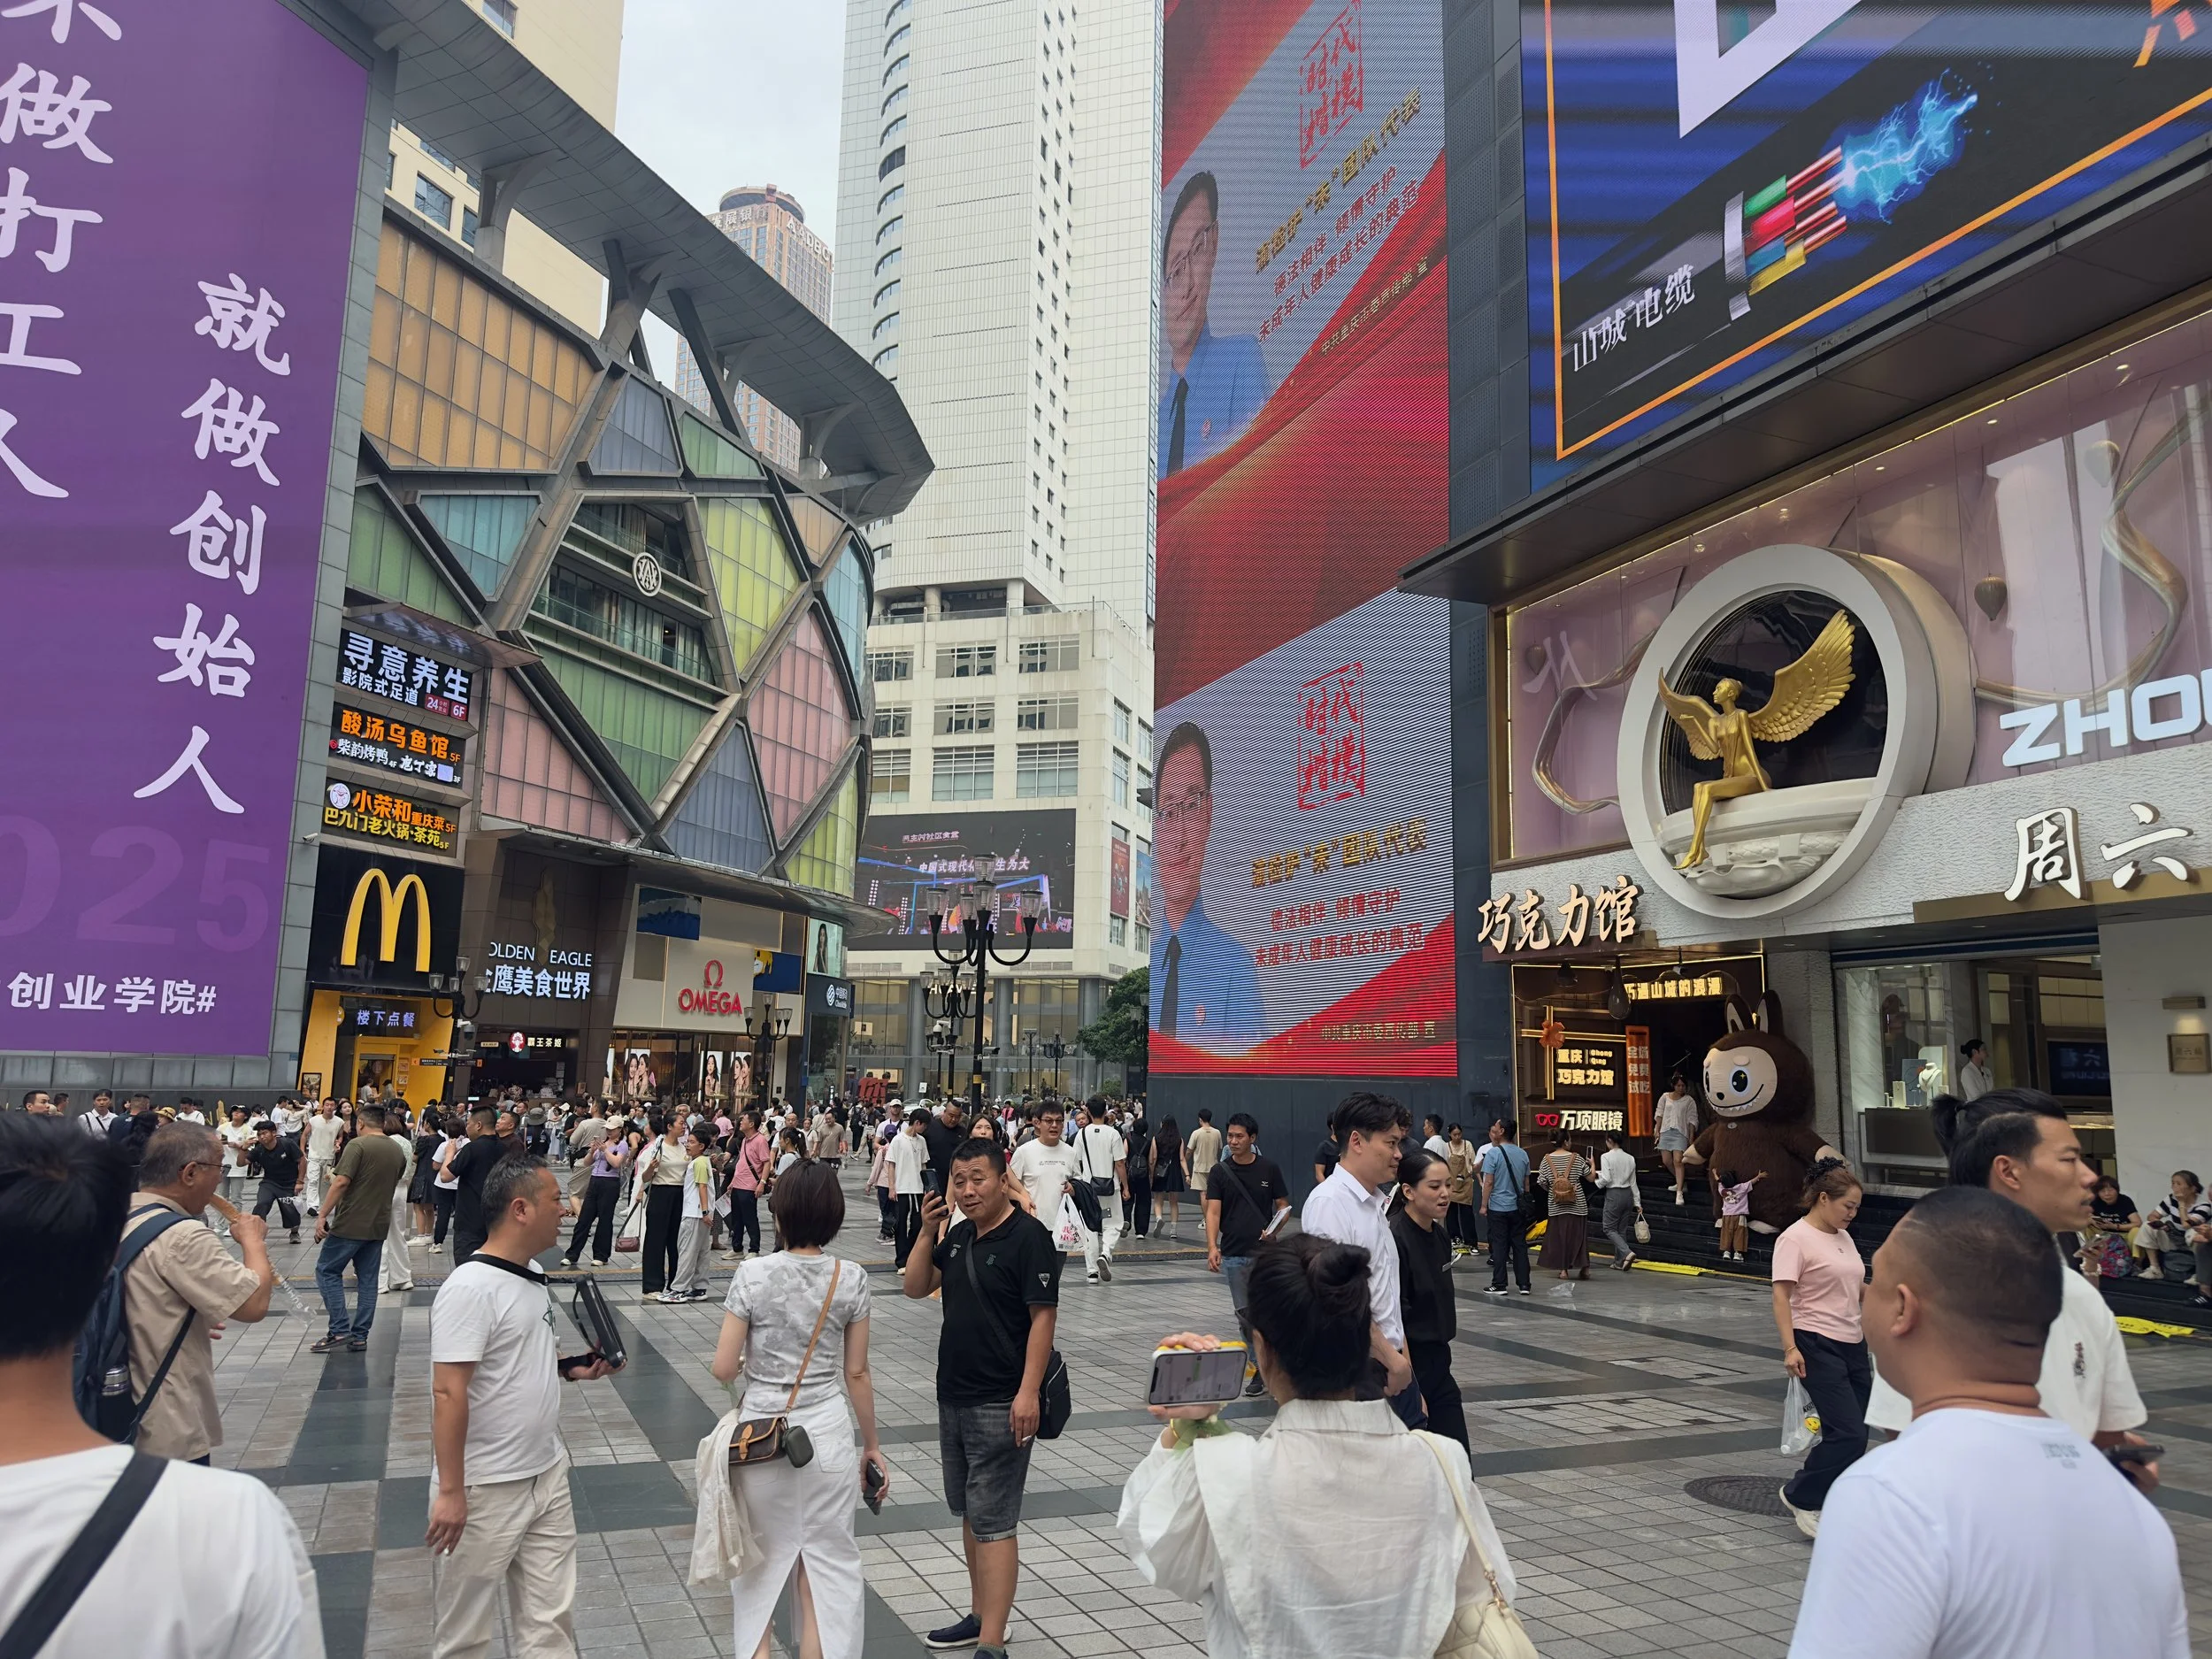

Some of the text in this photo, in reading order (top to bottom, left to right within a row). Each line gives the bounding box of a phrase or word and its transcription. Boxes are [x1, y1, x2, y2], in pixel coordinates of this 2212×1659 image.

[134, 273, 291, 814] 就做创始人
[342, 666, 419, 706] 影院式足道
[343, 632, 469, 704] 寻意养生
[453, 704, 465, 718] 6F
[1999, 668, 2212, 767] ZHO
[341, 710, 449, 759] 酸汤乌鱼馆
[2004, 802, 2190, 902] 周六
[1478, 874, 1639, 954] 巧克力馆
[549, 949, 592, 967] EAGLE
[357, 1009, 415, 1027] 楼下点餐
[678, 987, 742, 1016] OMEGA
[527, 1037, 562, 1048] 霸王茶姬
